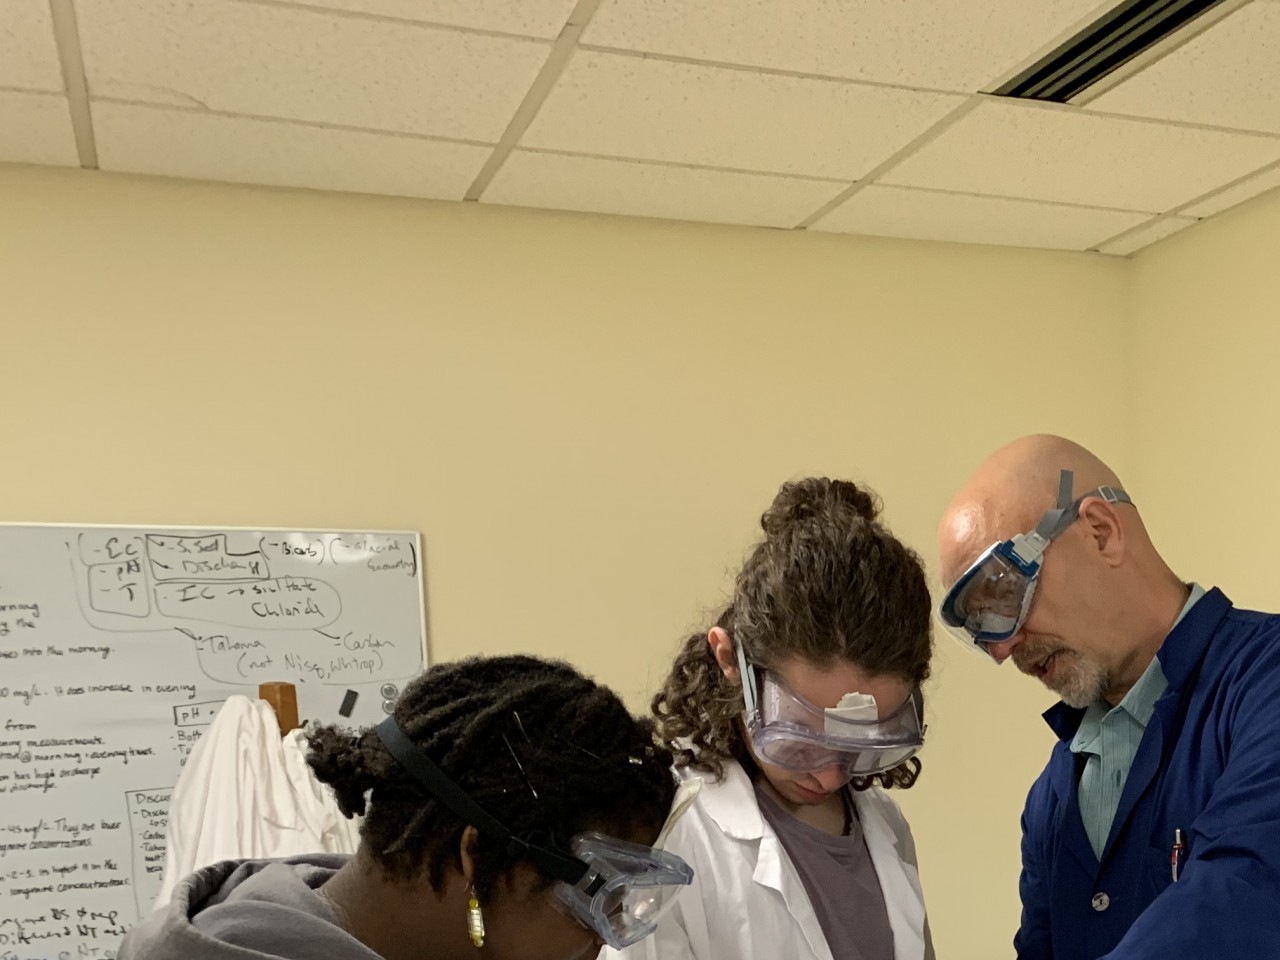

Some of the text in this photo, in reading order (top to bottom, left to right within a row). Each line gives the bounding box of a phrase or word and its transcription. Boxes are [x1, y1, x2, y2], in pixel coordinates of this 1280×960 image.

[156, 683, 196, 700] evening
[181, 708, 200, 724] pH
[5, 719, 38, 731] from
